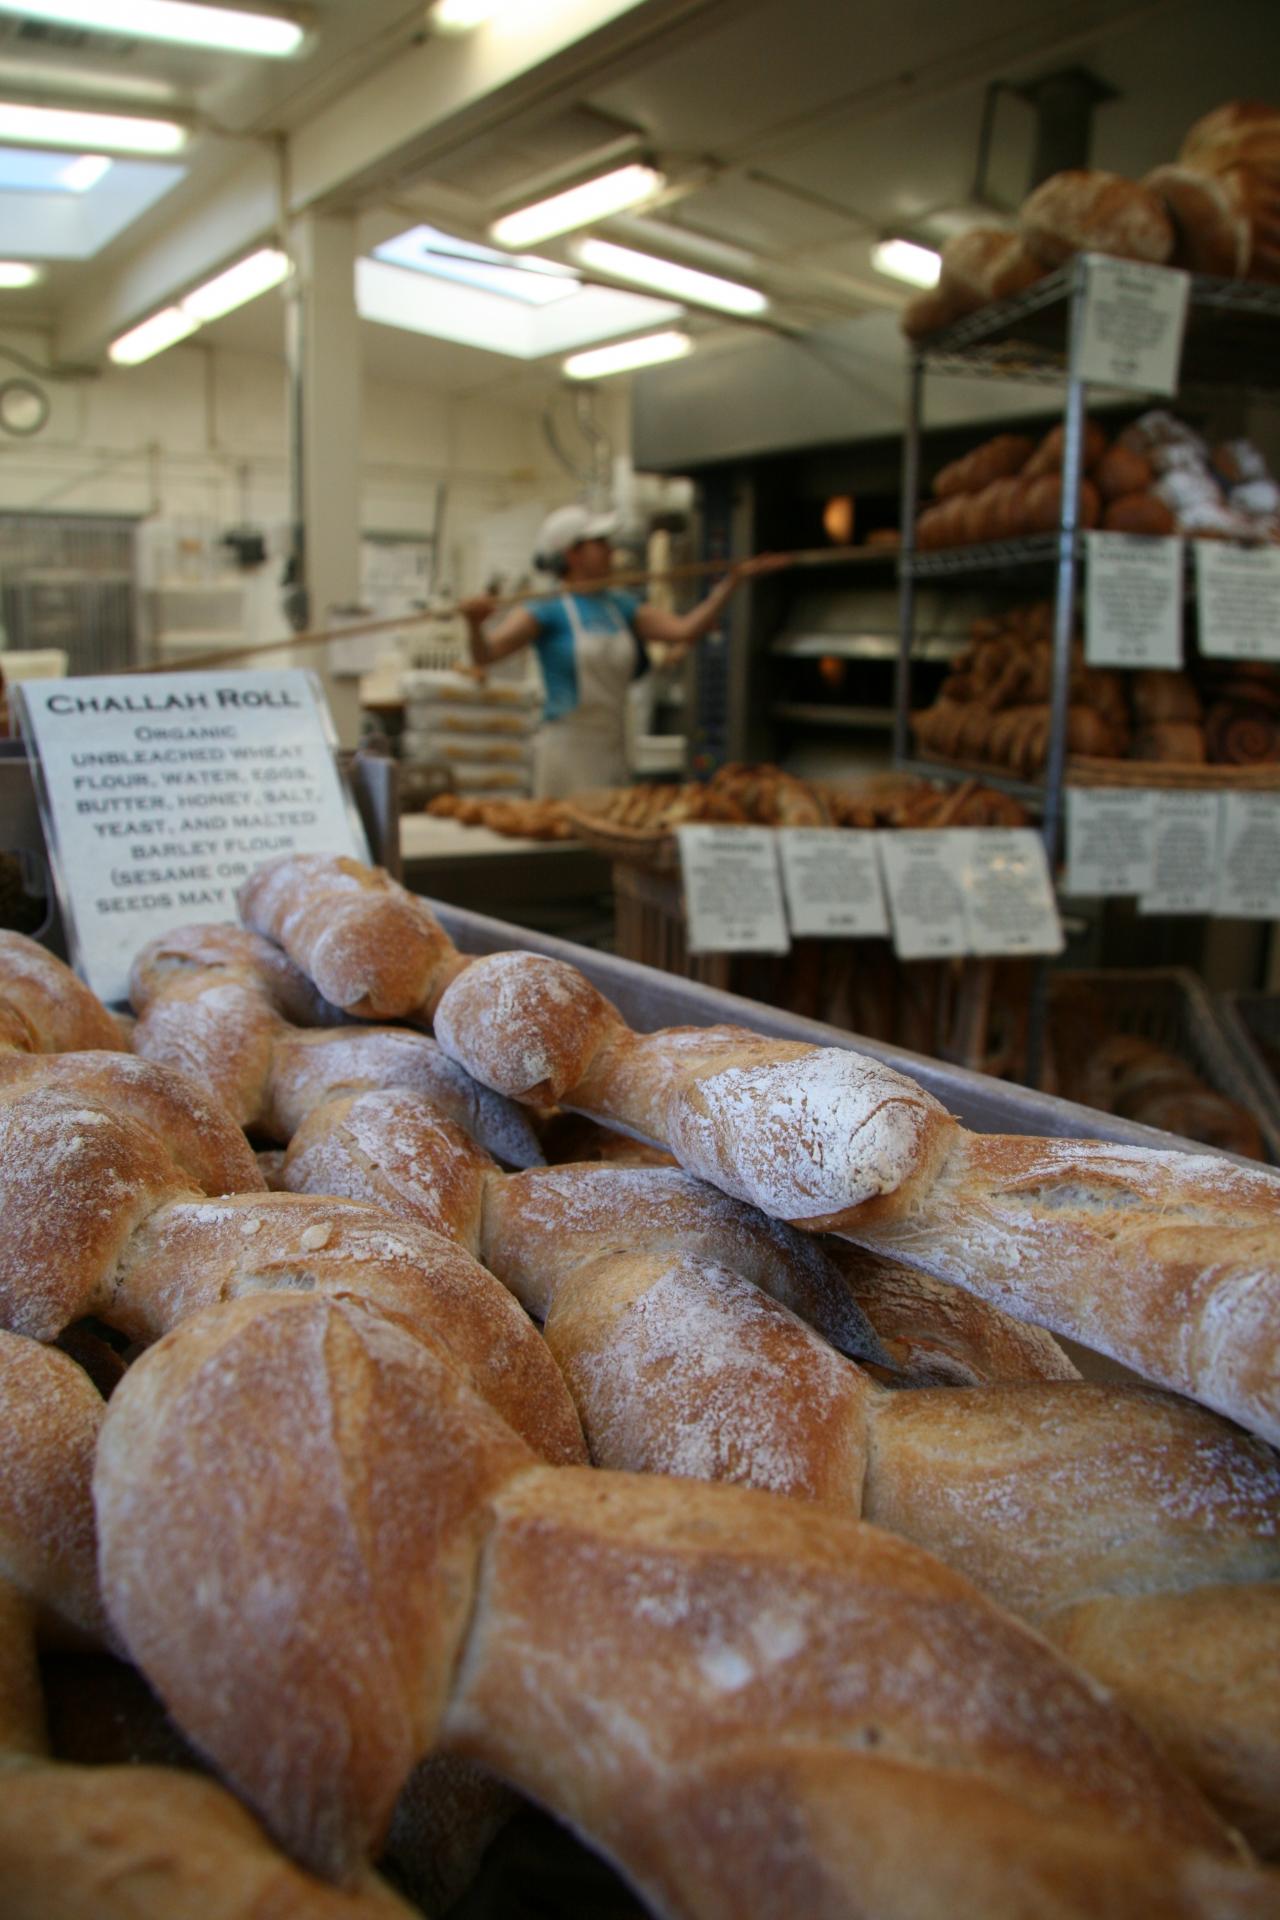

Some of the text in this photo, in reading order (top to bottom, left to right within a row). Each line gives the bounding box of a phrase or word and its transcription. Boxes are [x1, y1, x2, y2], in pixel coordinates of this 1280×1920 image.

[47, 689, 302, 715] CHALLAH ROLL
[134, 726, 238, 743] ORGANIC
[71, 745, 304, 768] UNBLEACHED WHEAT
[181, 814, 227, 832] AND
[233, 811, 317, 829] MALTED
[131, 836, 294, 860] BARLEY FLOUR
[217, 861, 248, 878] OR
[96, 895, 173, 913] SEEDS
[179, 889, 227, 907] MAY
